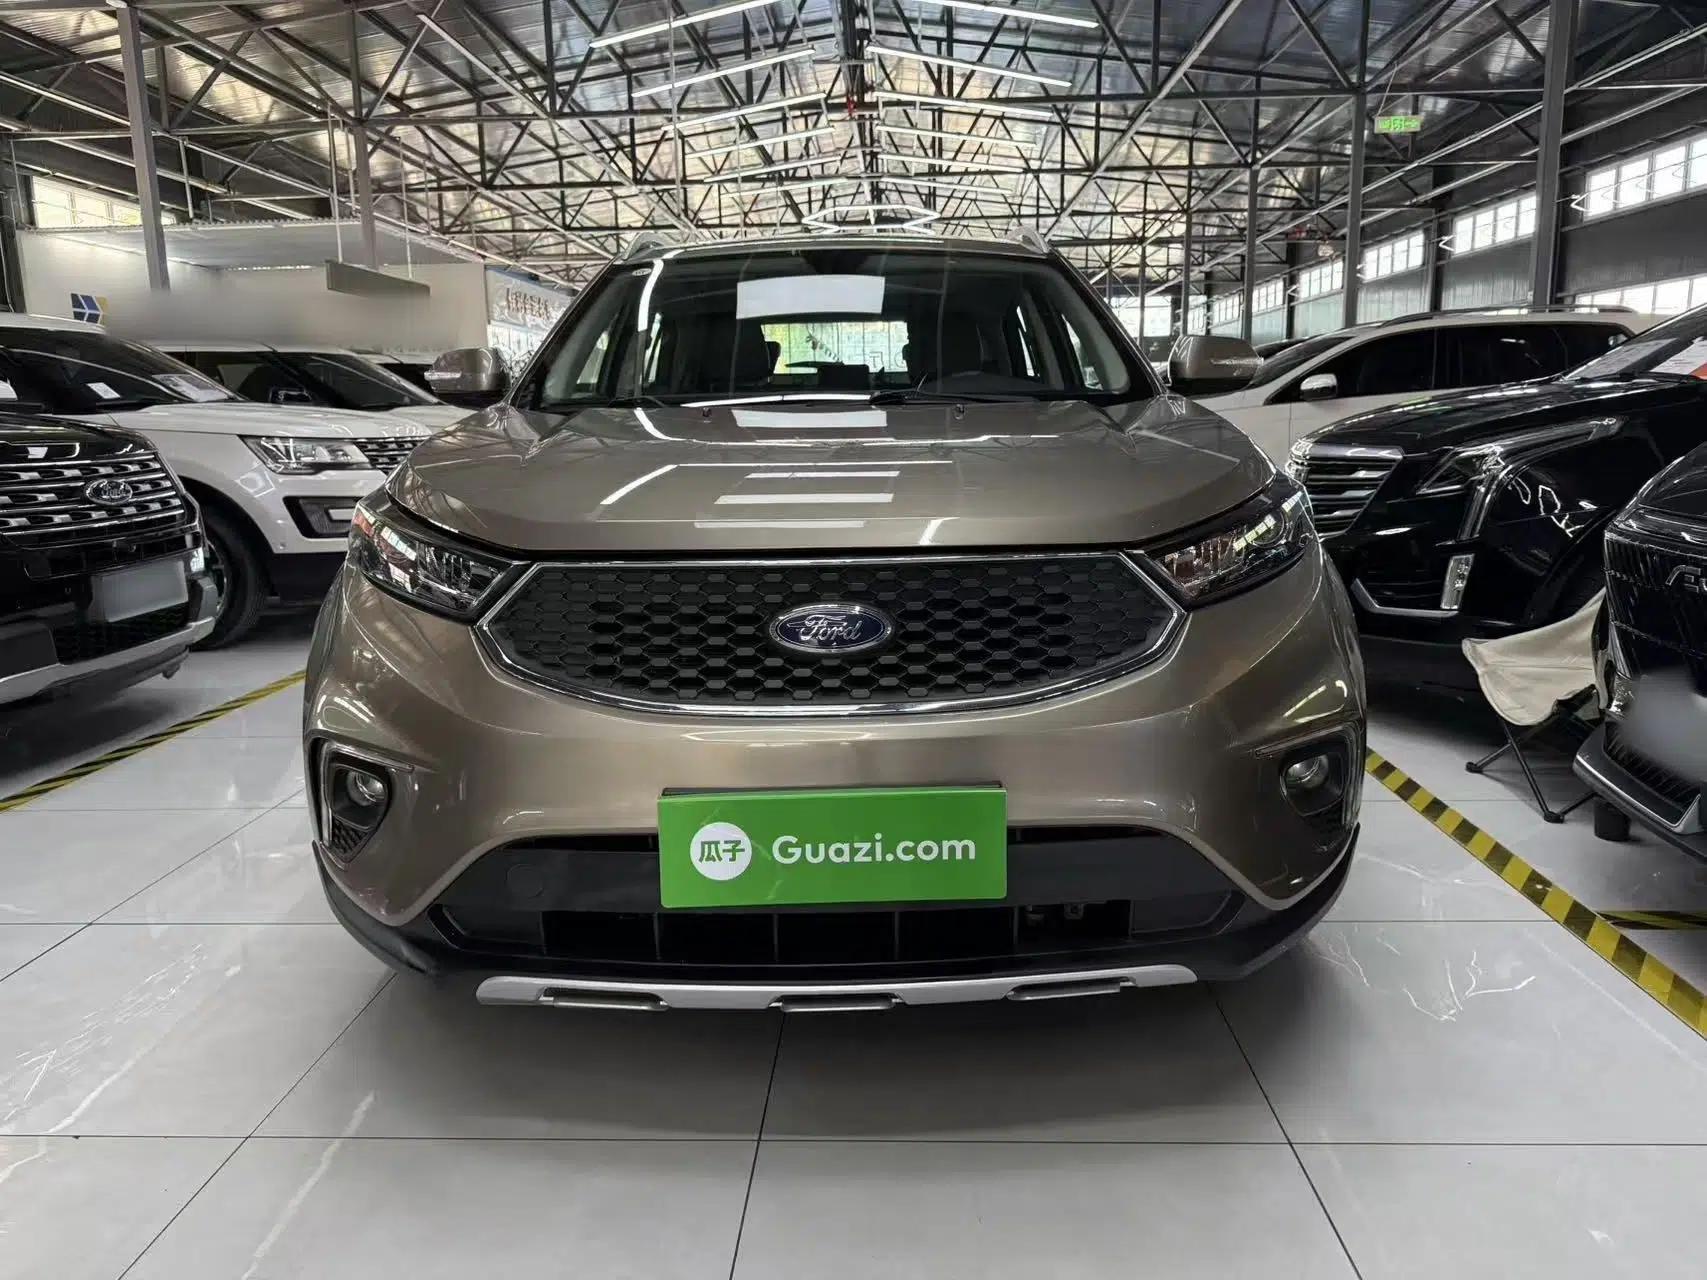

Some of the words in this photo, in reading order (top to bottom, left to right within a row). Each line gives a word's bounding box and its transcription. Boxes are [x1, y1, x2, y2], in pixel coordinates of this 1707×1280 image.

[787, 615, 862, 640] Ford
[699, 840, 745, 863] 瓜子
[772, 832, 976, 865] Guazi.com
